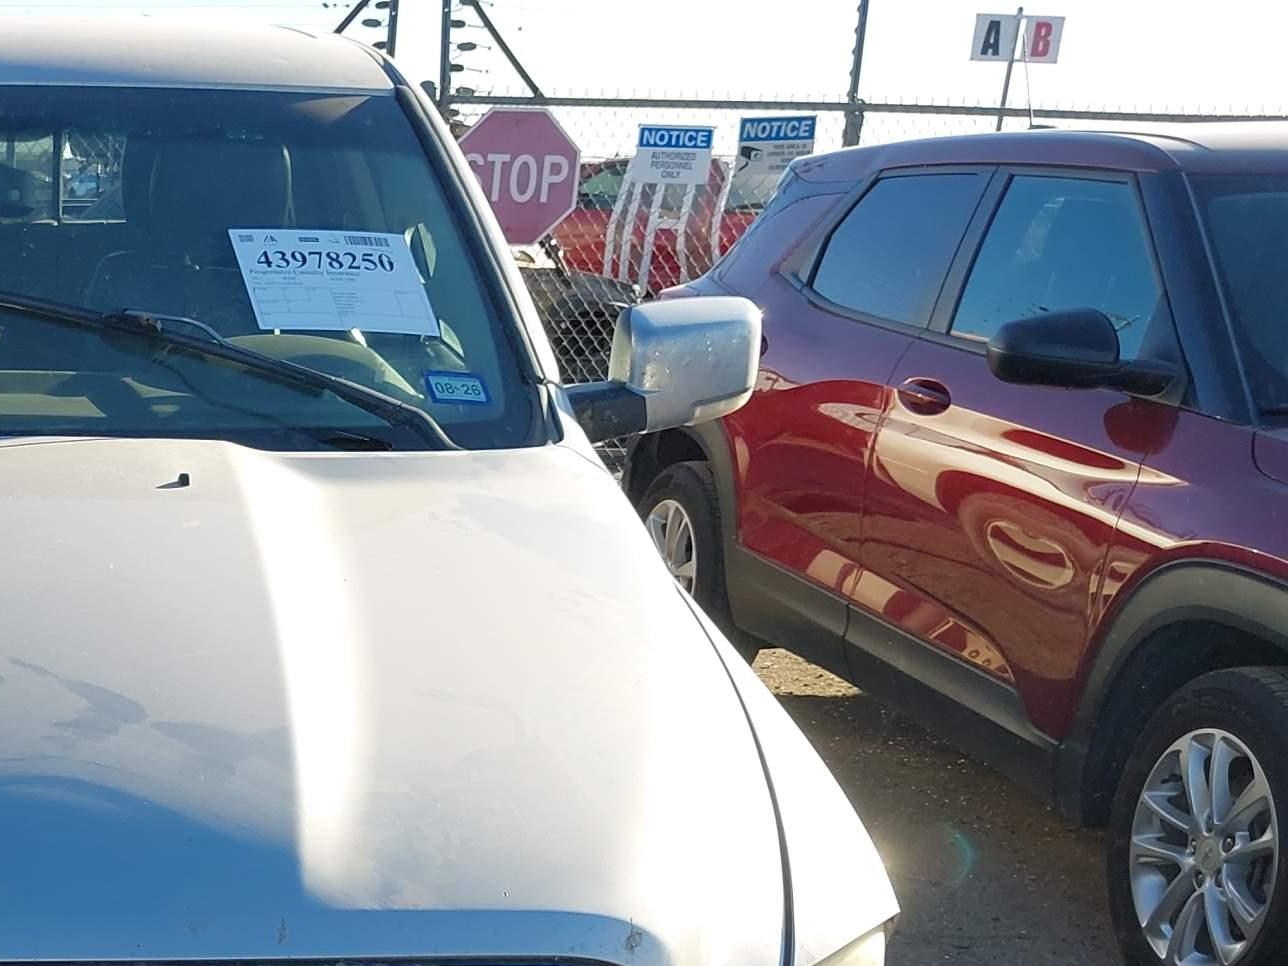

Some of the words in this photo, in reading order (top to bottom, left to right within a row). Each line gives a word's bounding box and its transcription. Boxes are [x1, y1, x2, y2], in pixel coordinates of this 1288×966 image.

[980, 20, 1001, 56] A
[1030, 21, 1053, 57] B
[743, 120, 812, 138] NOTICE
[642, 130, 710, 147] NOTICE
[661, 170, 680, 179] ONLY
[434, 382, 481, 396] 08-26
